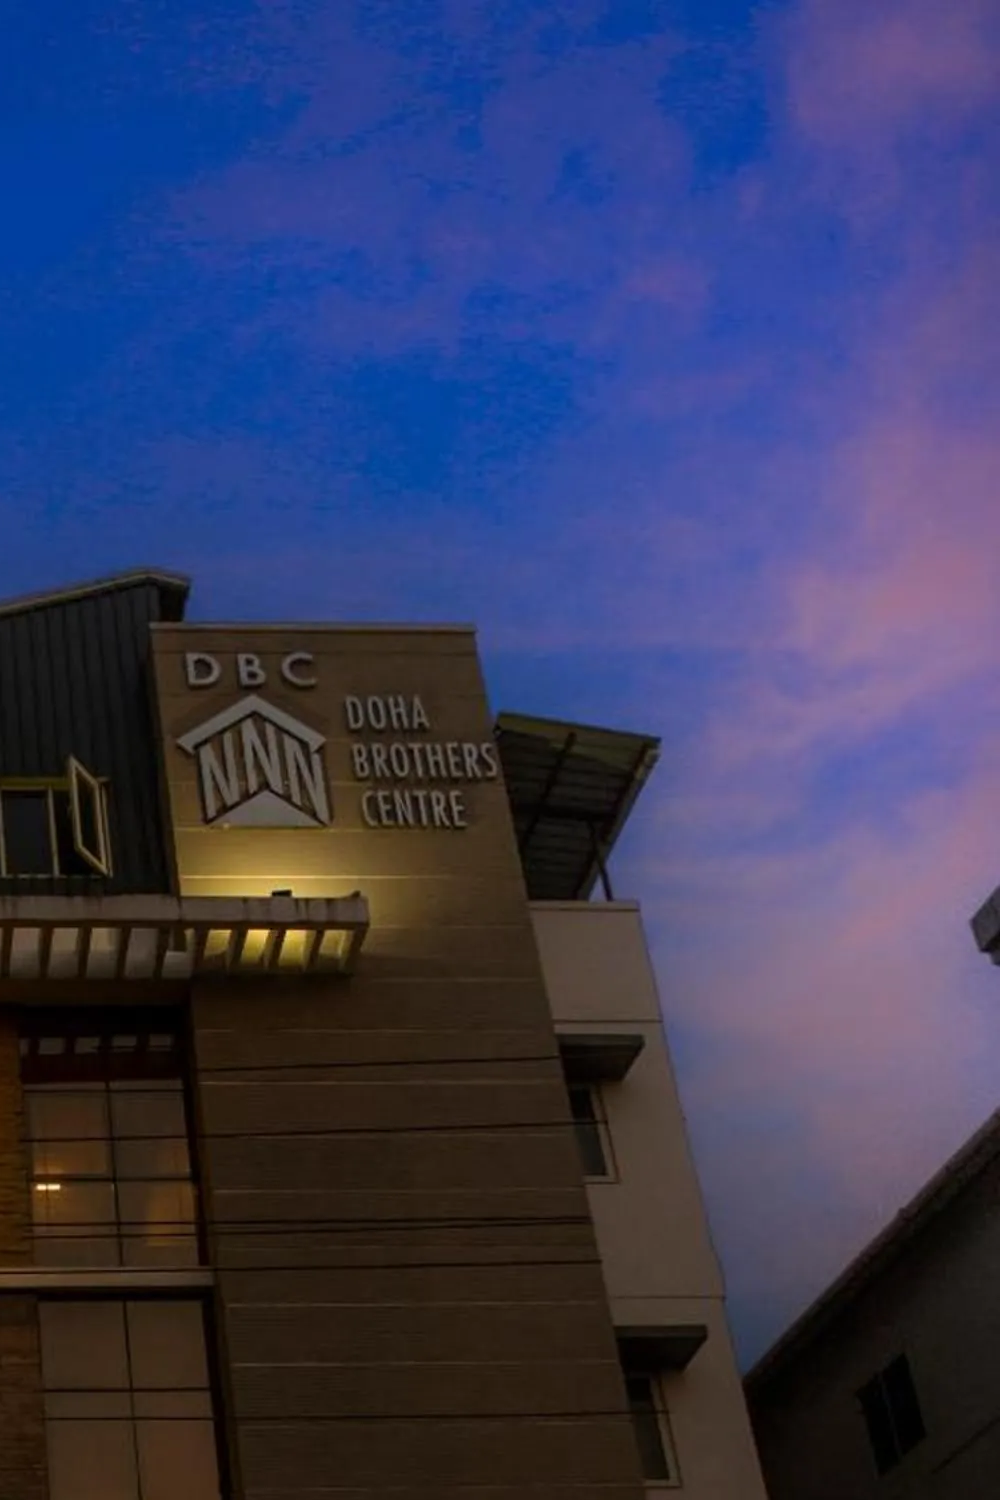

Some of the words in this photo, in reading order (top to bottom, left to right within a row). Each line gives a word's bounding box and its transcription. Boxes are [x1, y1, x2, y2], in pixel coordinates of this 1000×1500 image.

[185, 652, 318, 688] DBC
[345, 695, 431, 732] DOHA
[352, 741, 499, 779] BROTHERS
[361, 790, 469, 829] CENTRE
